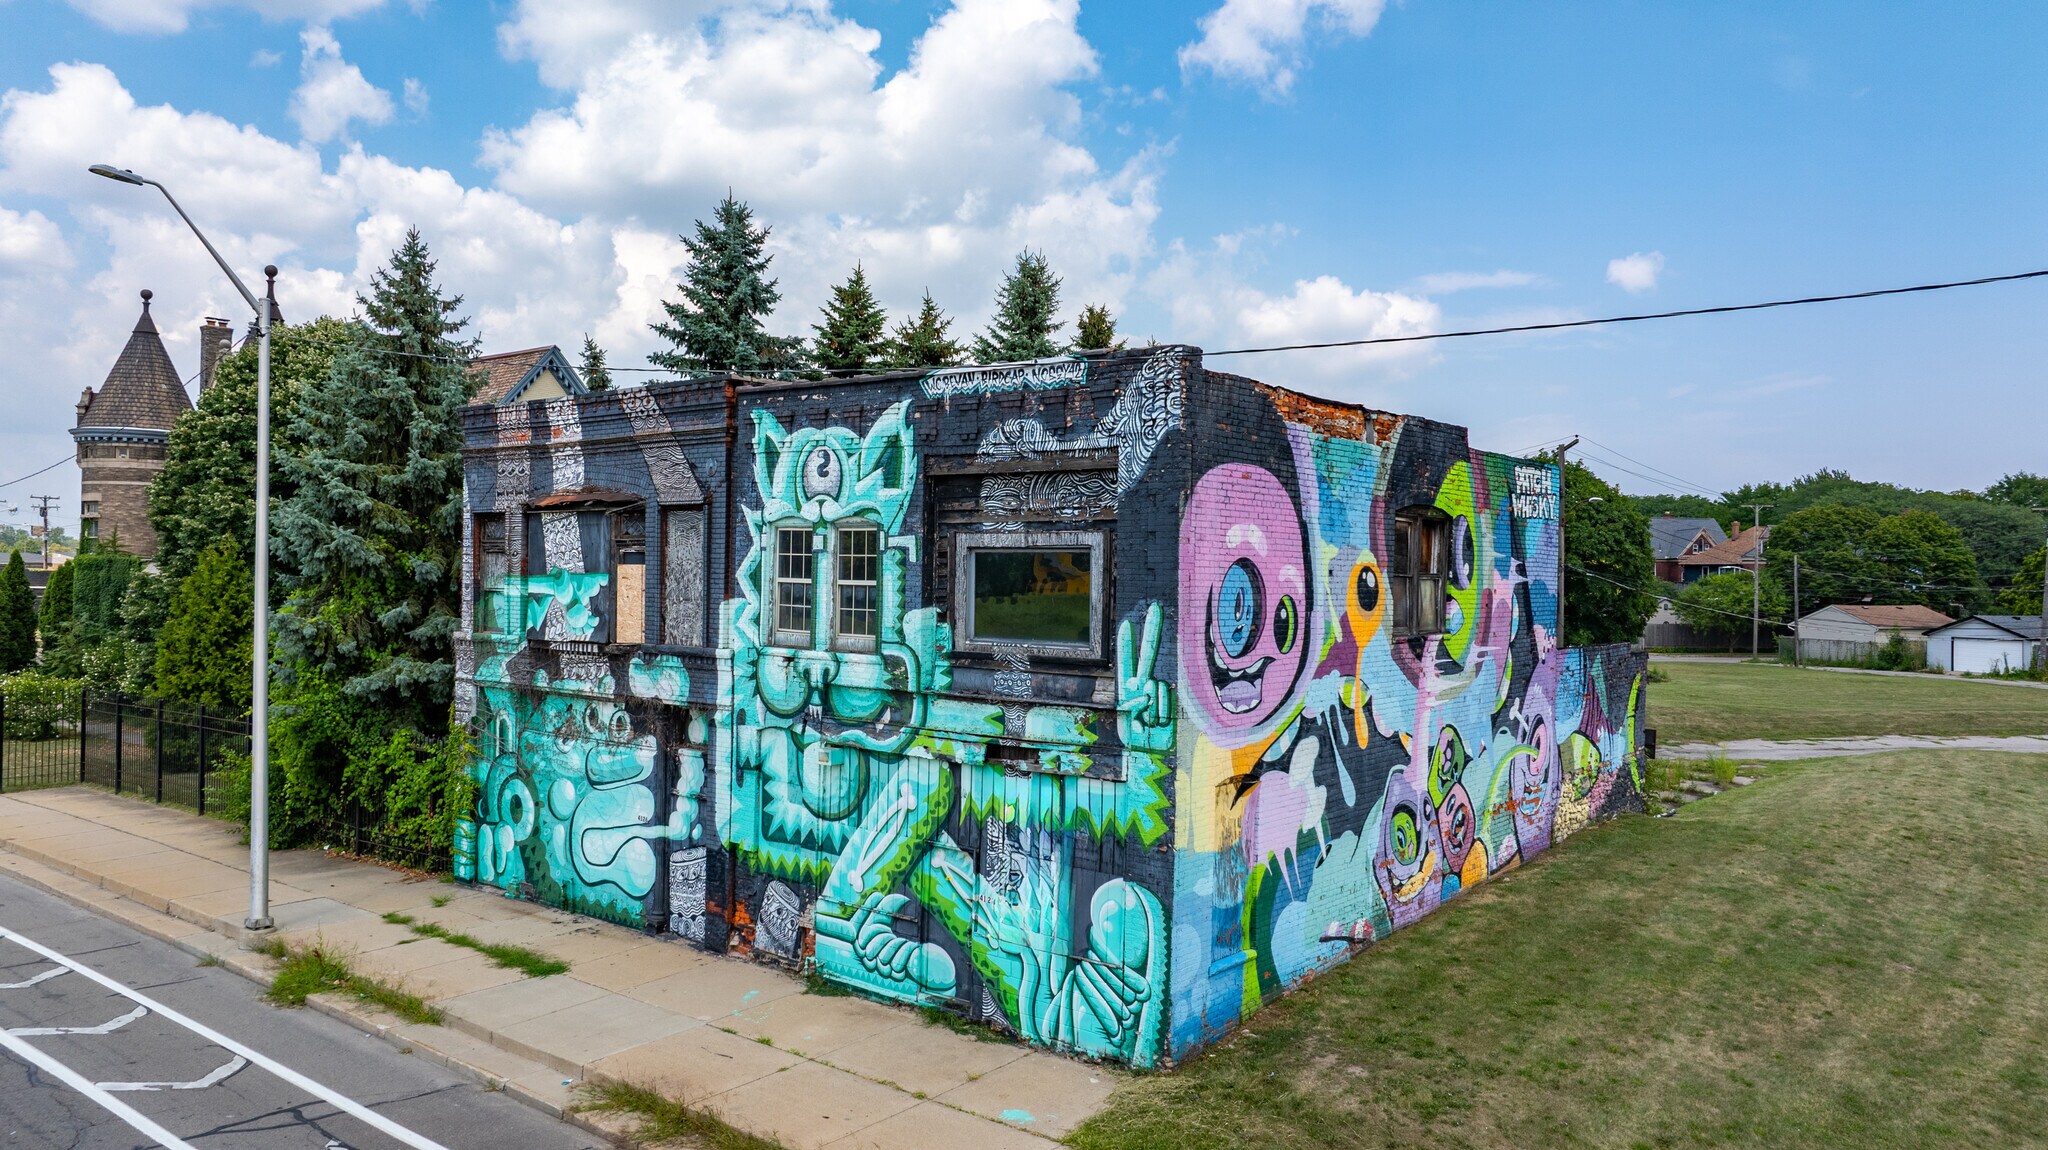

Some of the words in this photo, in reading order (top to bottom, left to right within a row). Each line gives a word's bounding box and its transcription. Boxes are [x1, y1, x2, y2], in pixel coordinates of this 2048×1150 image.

[981, 368, 1025, 386] BIRDCAP
[1514, 466, 1552, 494] PATCH
[1511, 493, 1556, 520] WHISKY
